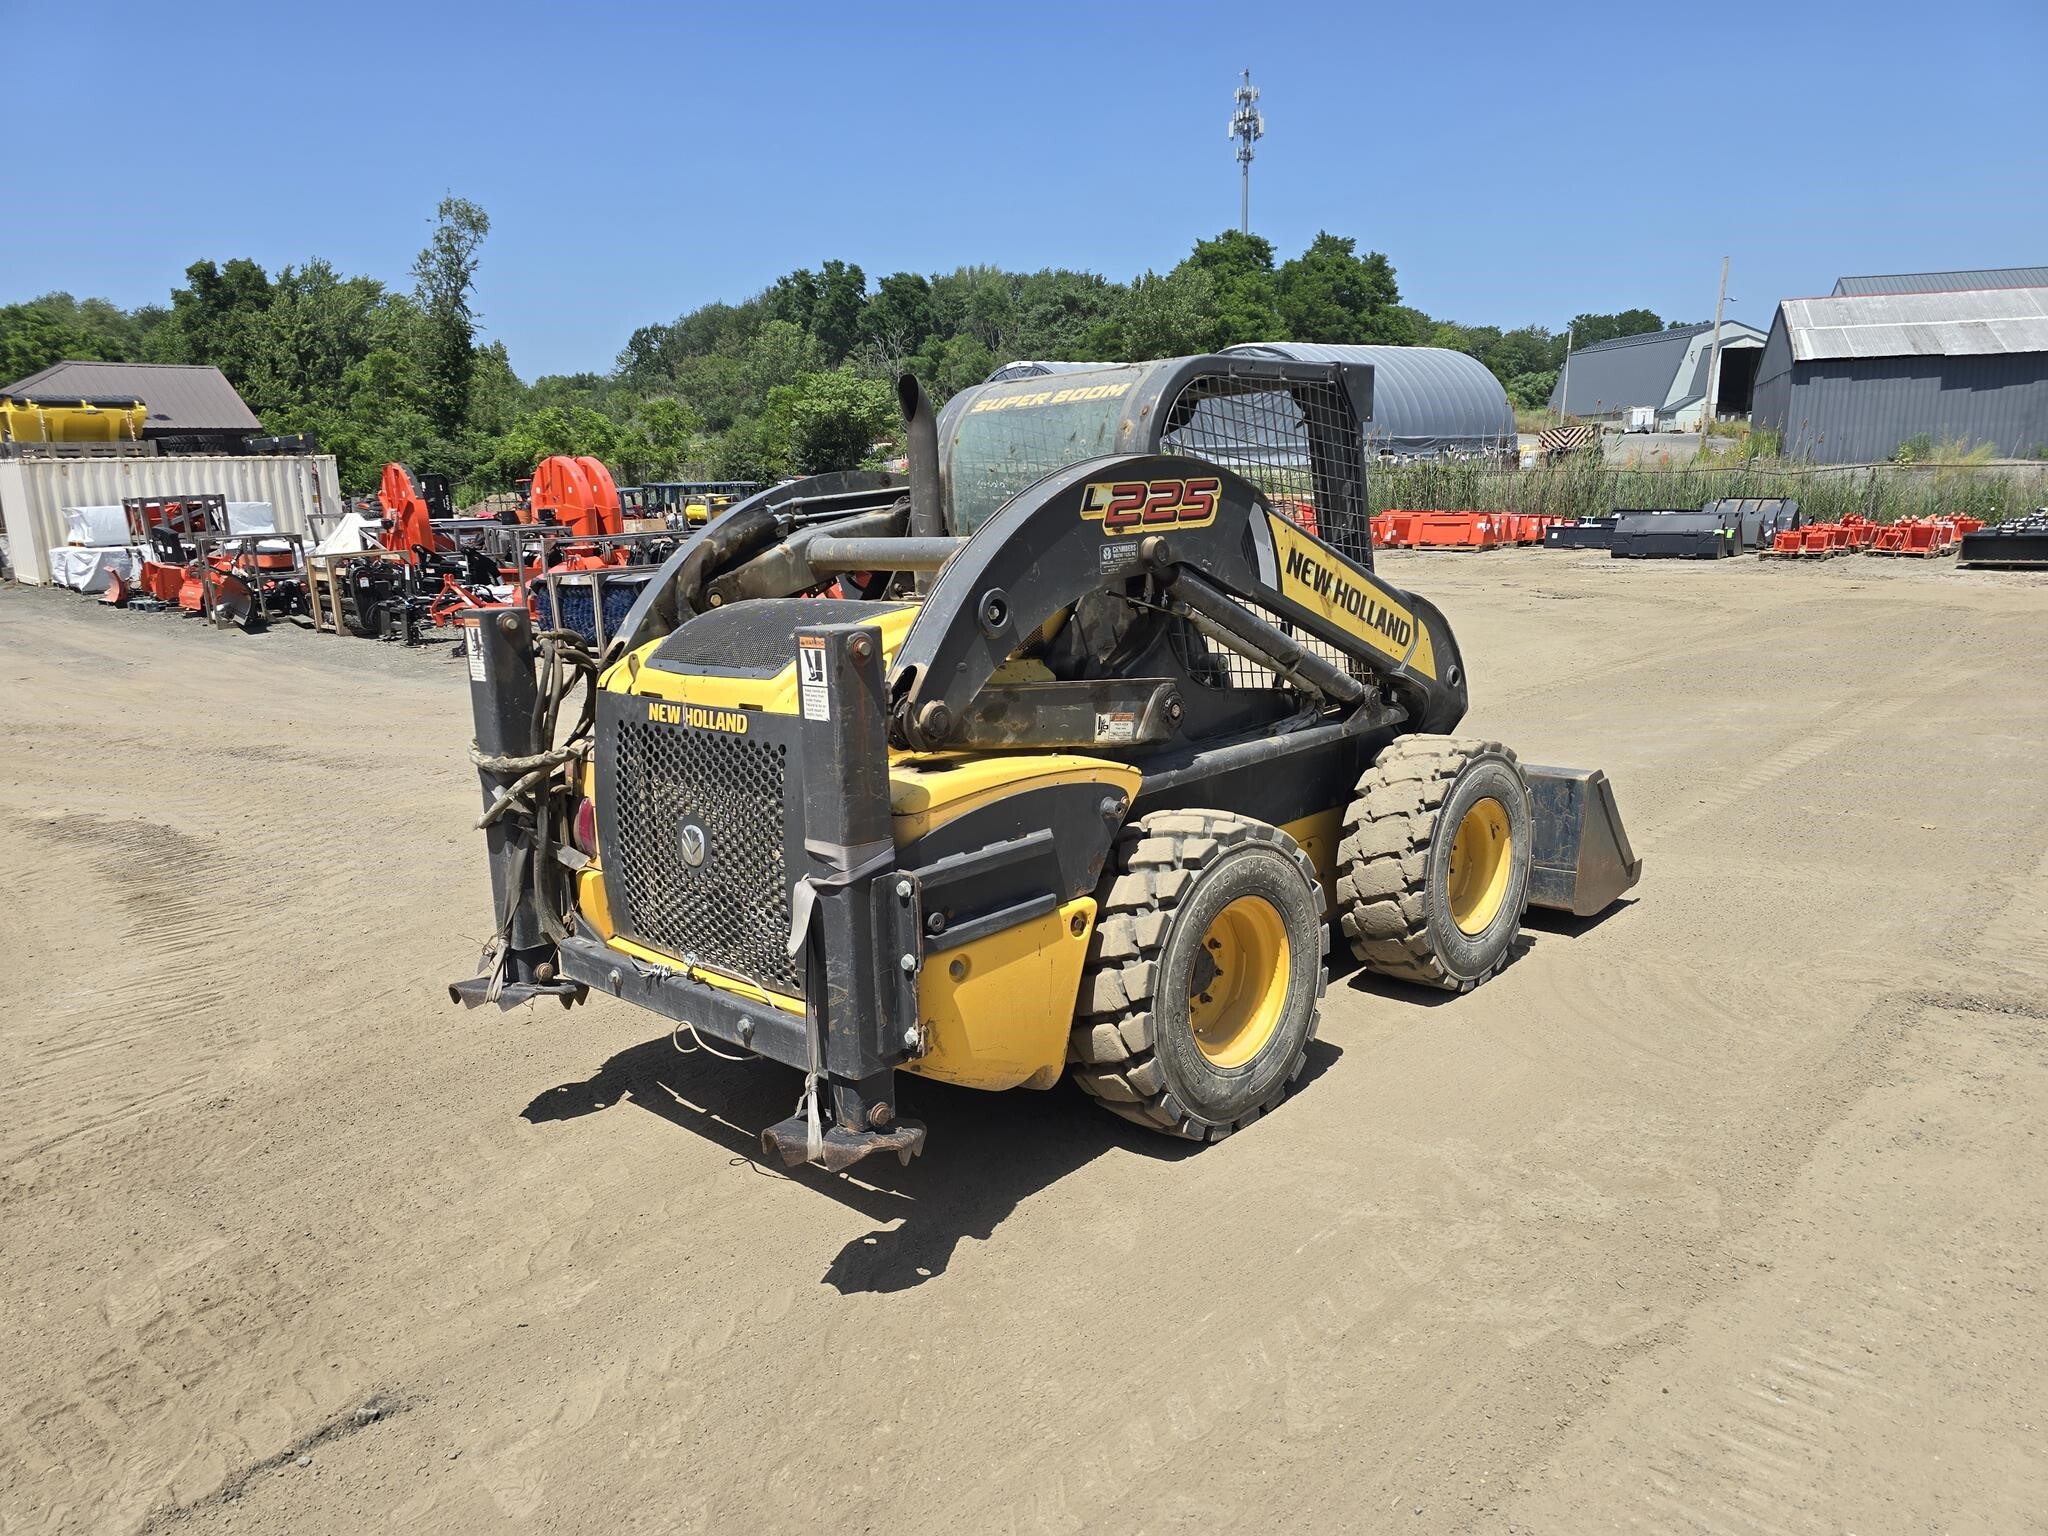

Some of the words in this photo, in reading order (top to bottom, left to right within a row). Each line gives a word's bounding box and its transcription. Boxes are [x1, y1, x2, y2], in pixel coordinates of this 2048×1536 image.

[971, 391, 1053, 413] SUPER
[1052, 382, 1133, 402] BOOM
[1286, 547, 1333, 597] NEW
[1333, 577, 1411, 647] HOLLAND
[648, 702, 680, 725] NEW
[685, 706, 748, 734] HOLLAND
